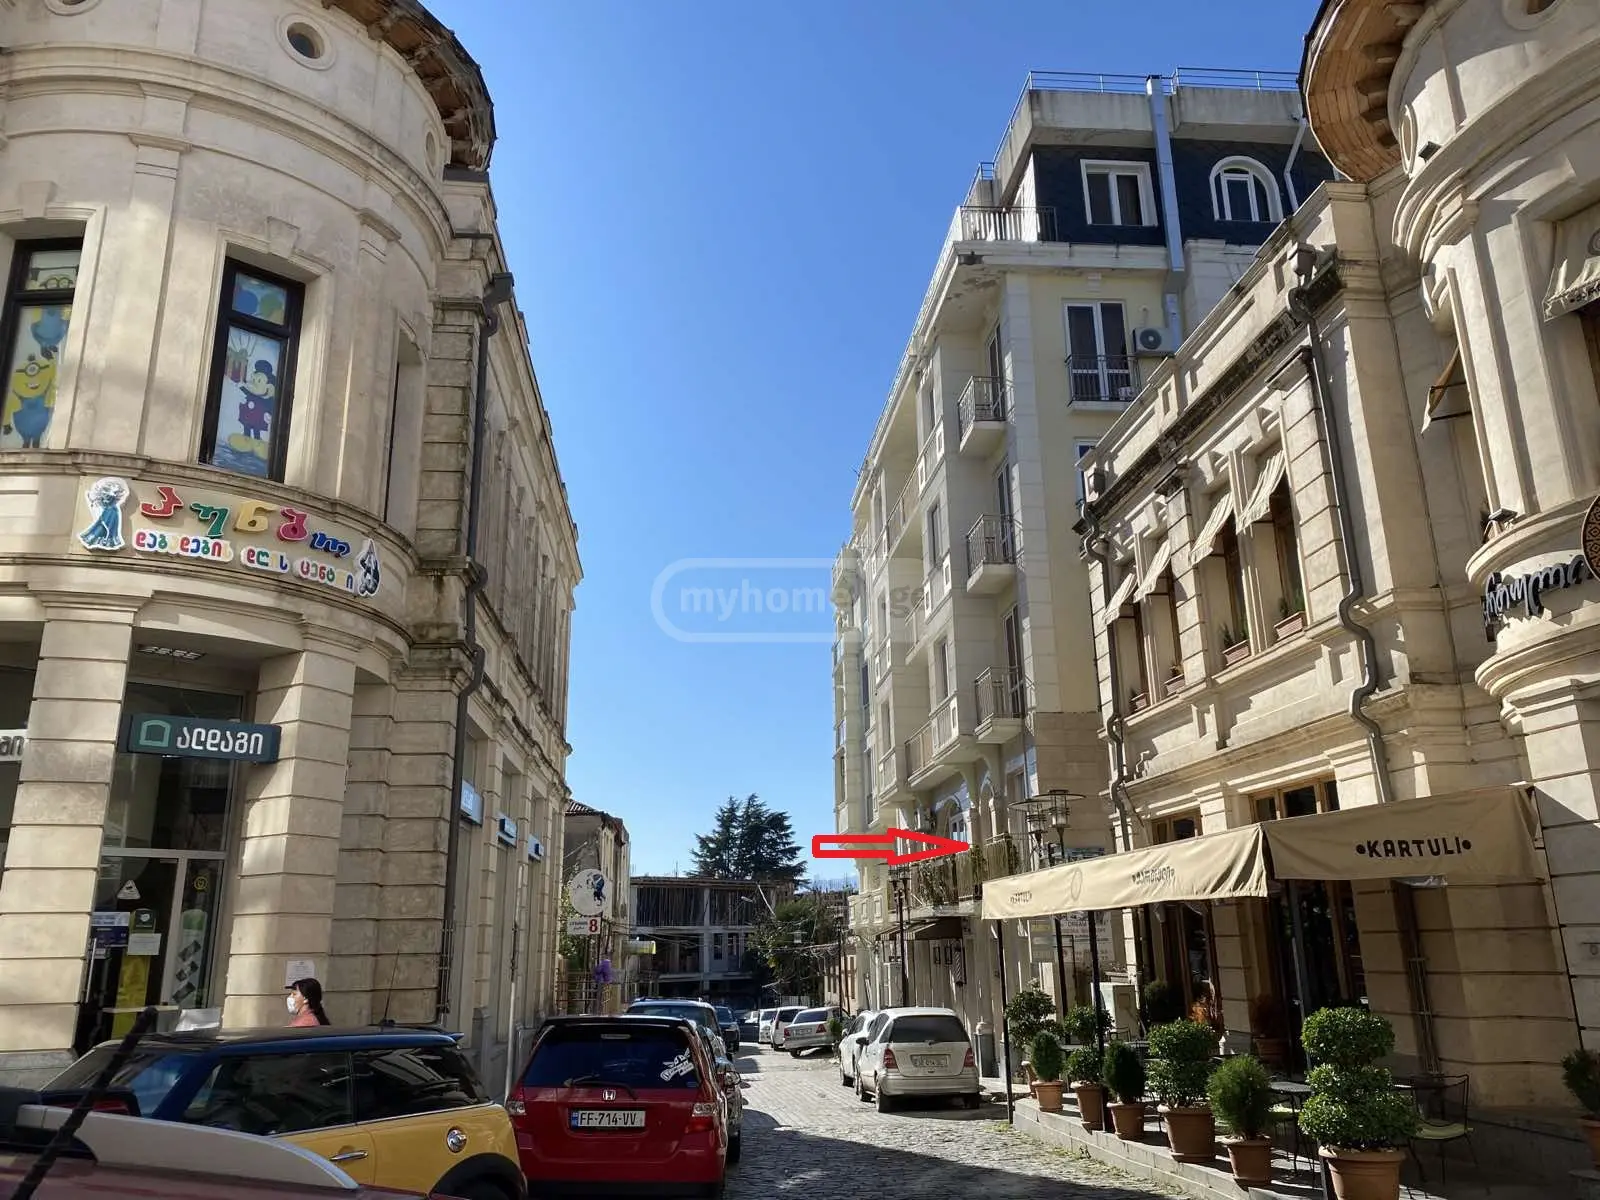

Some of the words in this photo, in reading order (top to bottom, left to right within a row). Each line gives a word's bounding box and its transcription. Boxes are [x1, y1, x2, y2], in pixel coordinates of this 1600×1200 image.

[176, 726, 264, 755] ალდაგი
[1366, 836, 1462, 858] KARTULI
[589, 918, 598, 933] 8
[579, 1111, 637, 1126] FF-714-VV
